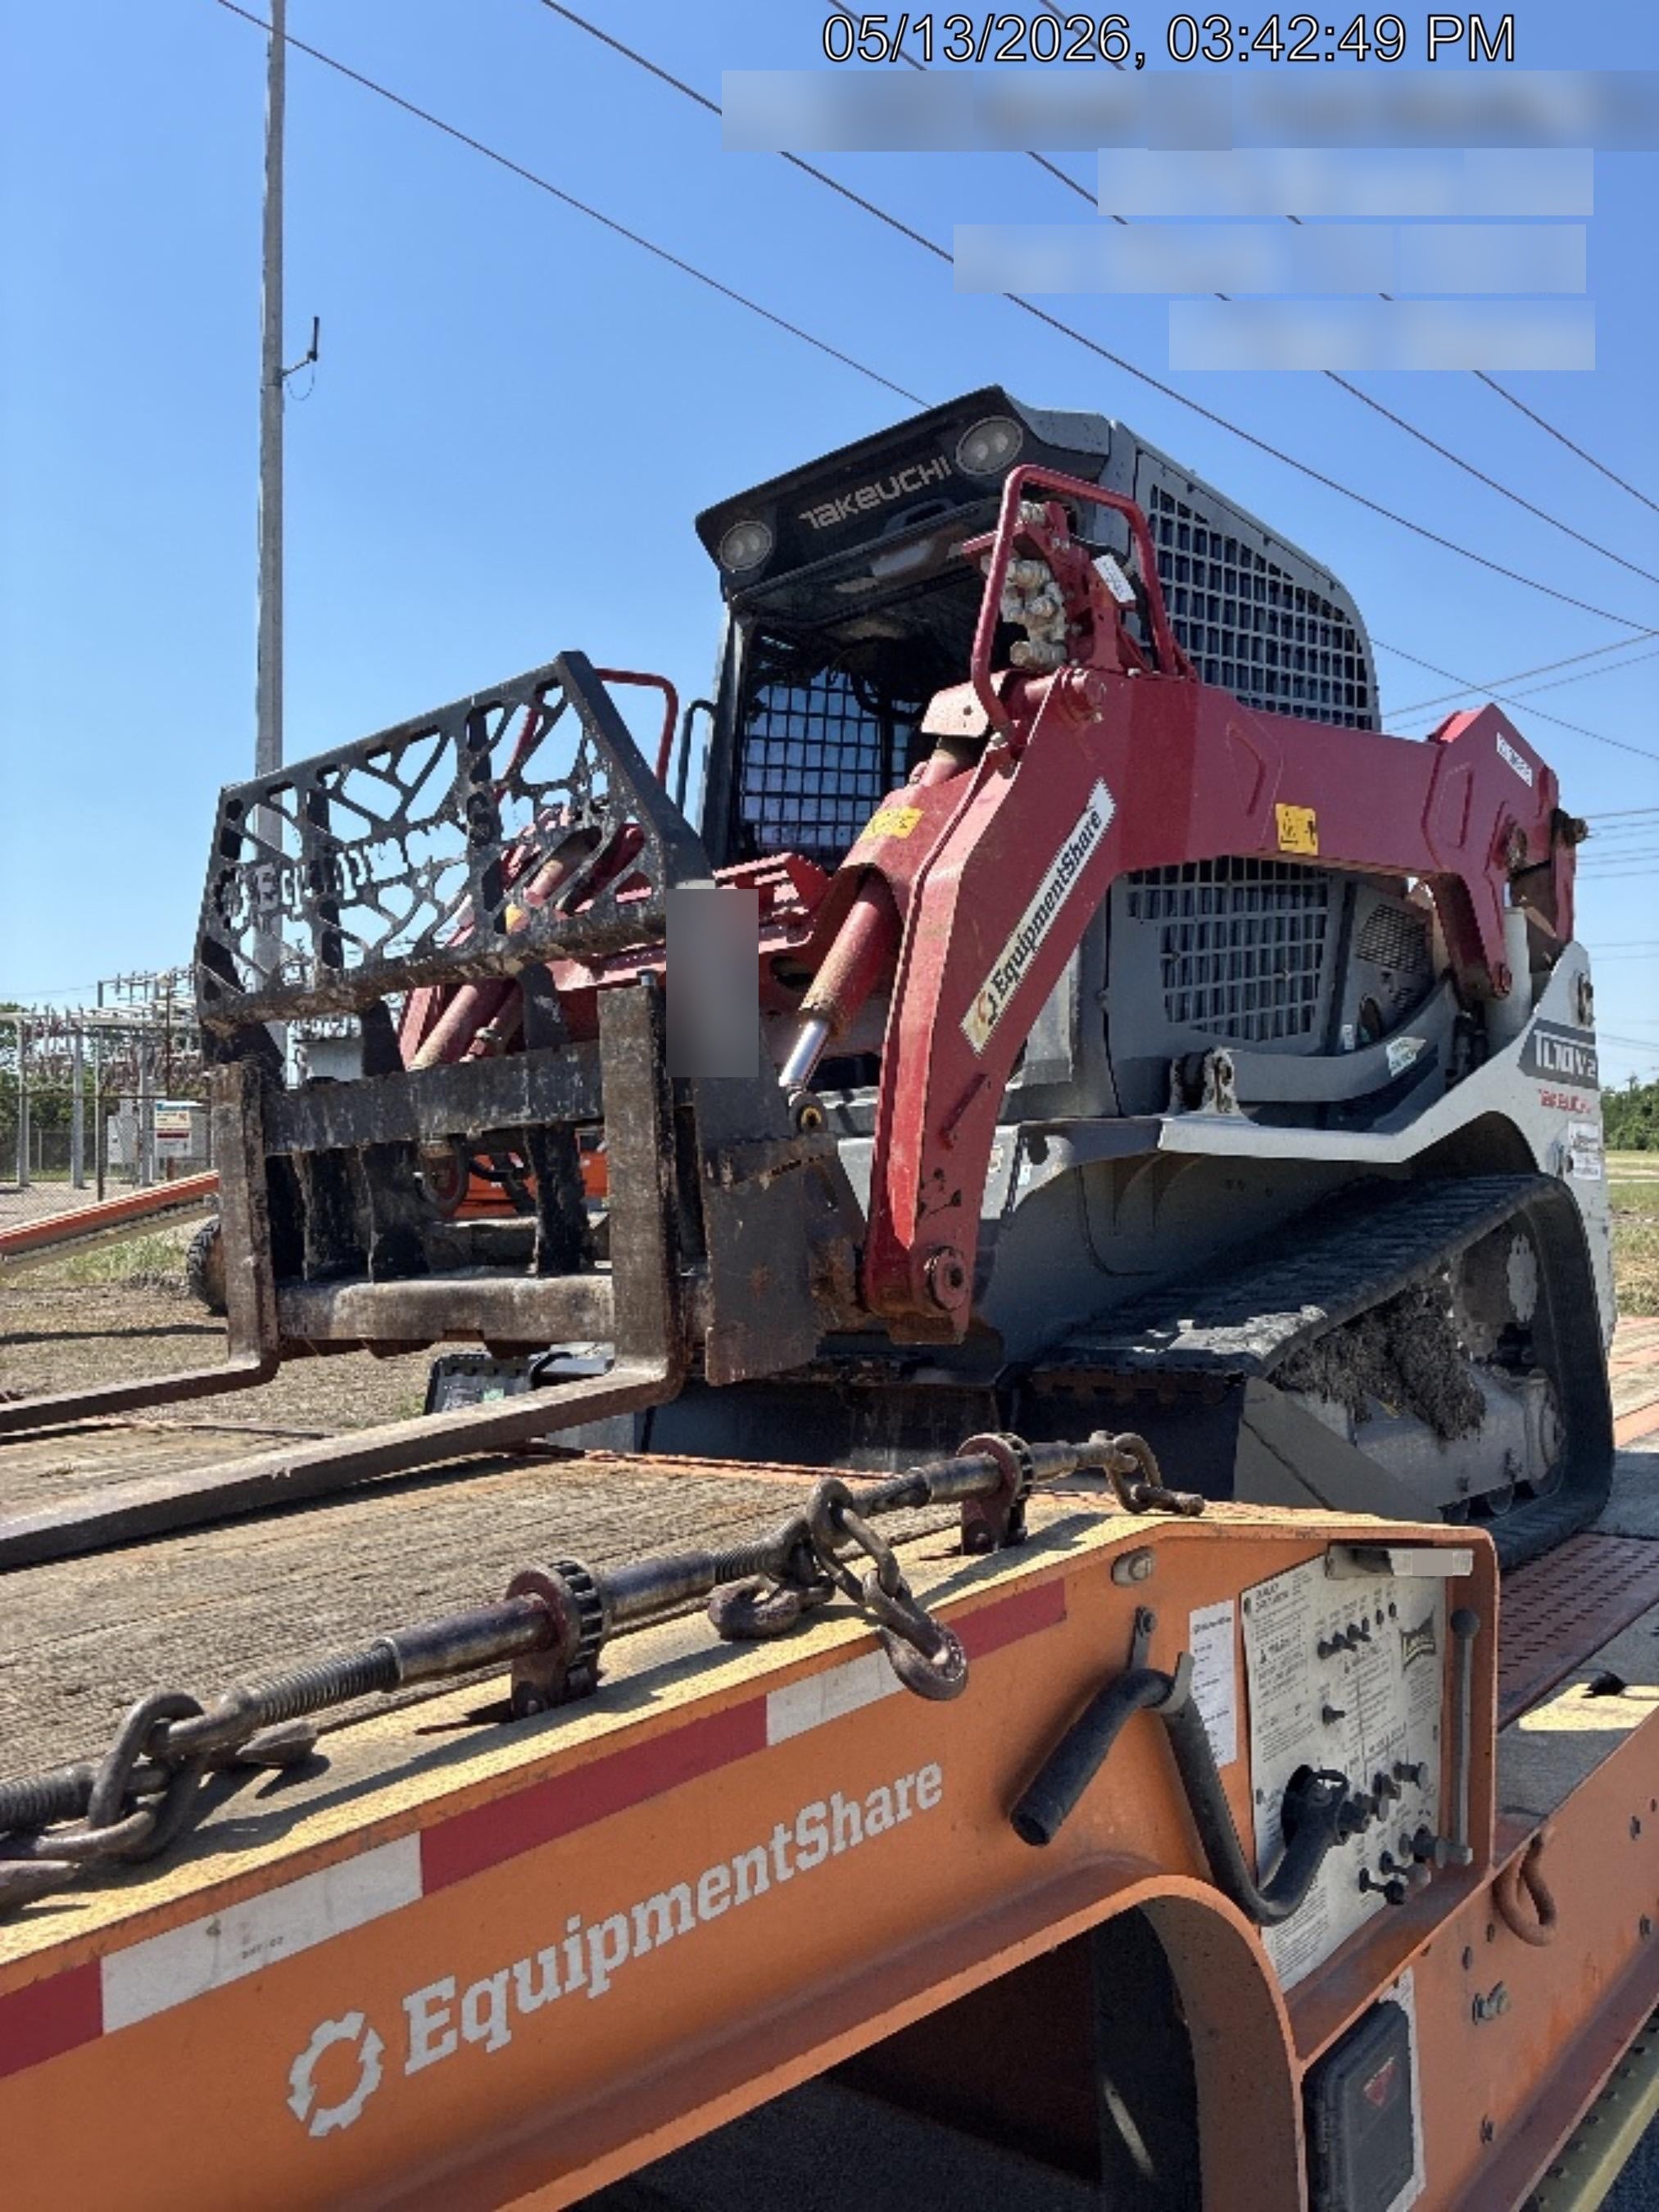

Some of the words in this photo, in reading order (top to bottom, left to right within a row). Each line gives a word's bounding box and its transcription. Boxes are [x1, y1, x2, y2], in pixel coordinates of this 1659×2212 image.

[798, 454, 953, 529] TAKEUCHI
[990, 809, 1102, 1001] EquipmentShare
[402, 1761, 943, 2076] EquipmentShare
